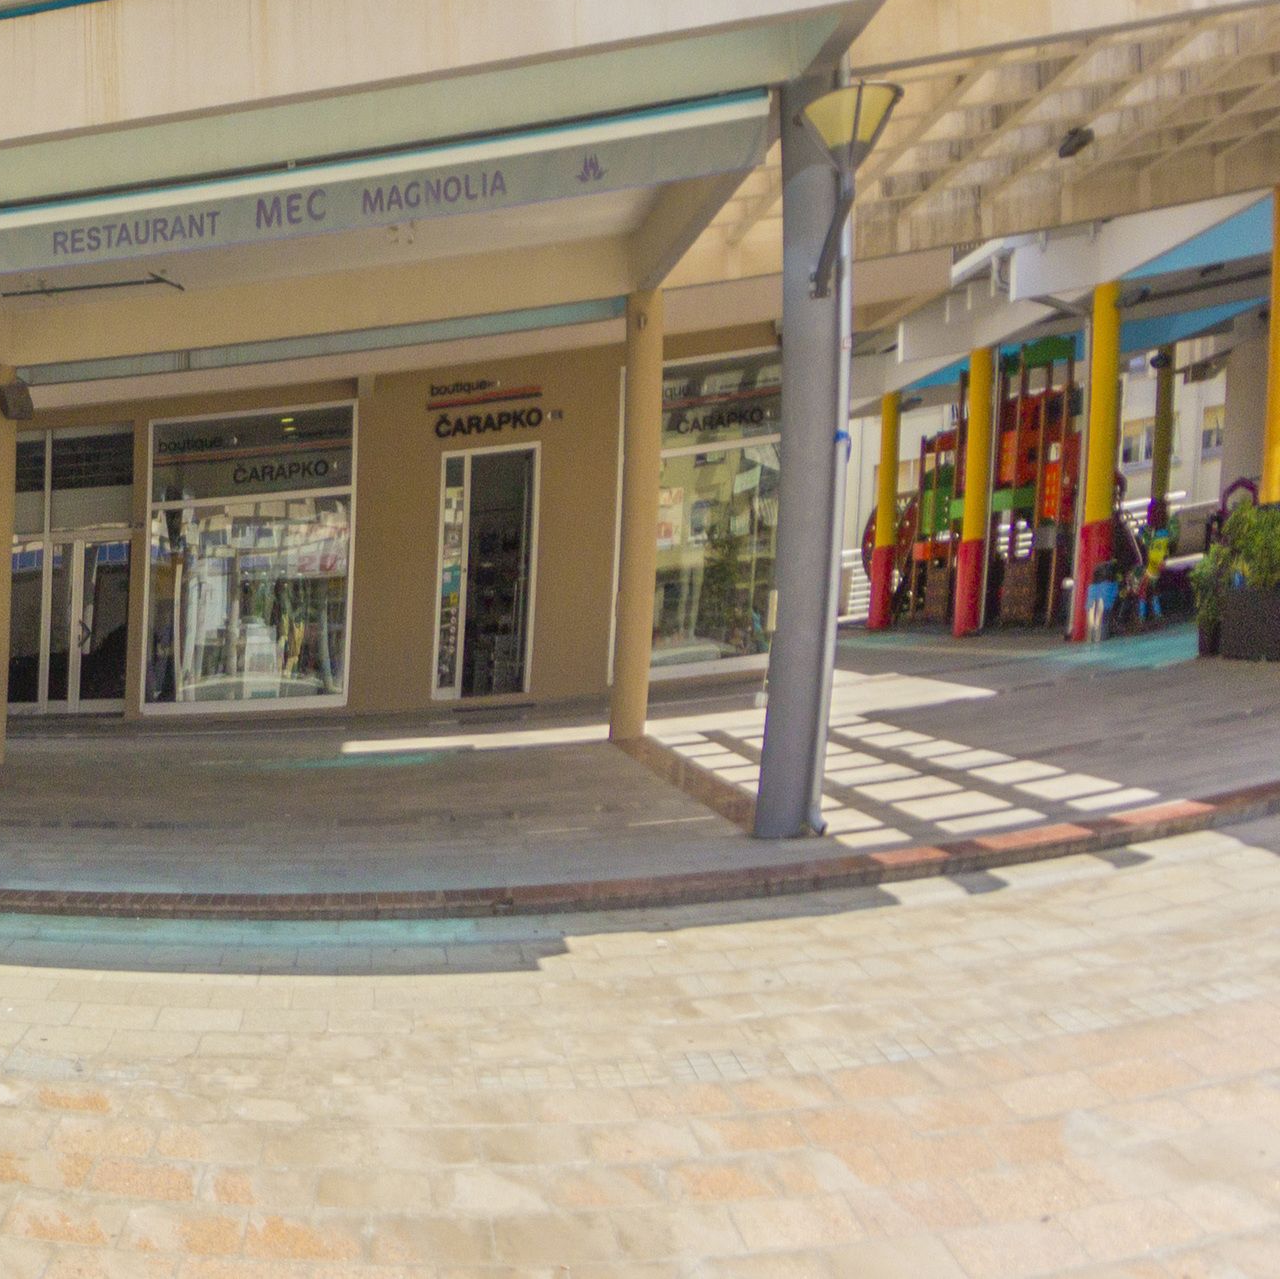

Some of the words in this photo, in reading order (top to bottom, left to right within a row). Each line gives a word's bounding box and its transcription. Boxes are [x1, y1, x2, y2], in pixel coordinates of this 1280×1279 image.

[52, 210, 220, 255] RESTAURANT
[255, 189, 327, 229] MEC
[361, 170, 507, 215] MAGNOLIA
[430, 379, 489, 397] boutique
[435, 407, 543, 438] ČARAPKO
[158, 435, 224, 453] boutique
